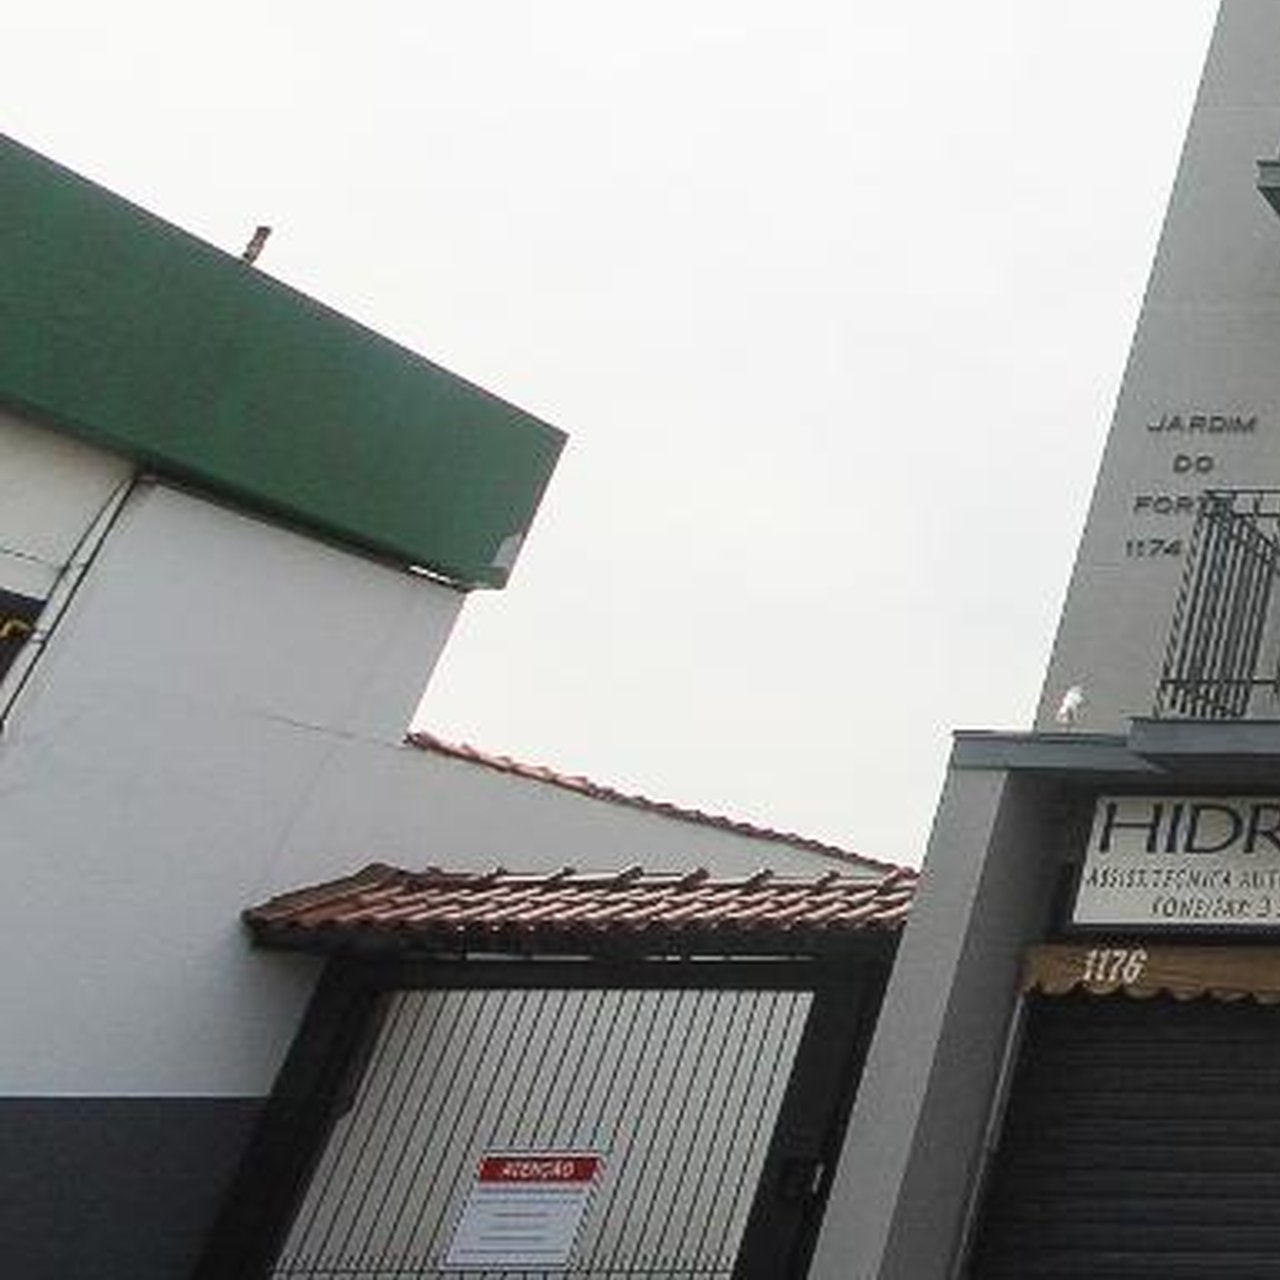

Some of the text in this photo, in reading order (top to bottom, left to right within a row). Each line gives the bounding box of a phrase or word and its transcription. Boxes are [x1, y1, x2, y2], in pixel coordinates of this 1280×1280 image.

[1147, 416, 1256, 432] JARDIM
[1173, 454, 1214, 473] DO
[1126, 538, 1181, 557] 1174
[1083, 949, 1148, 983] 1176
